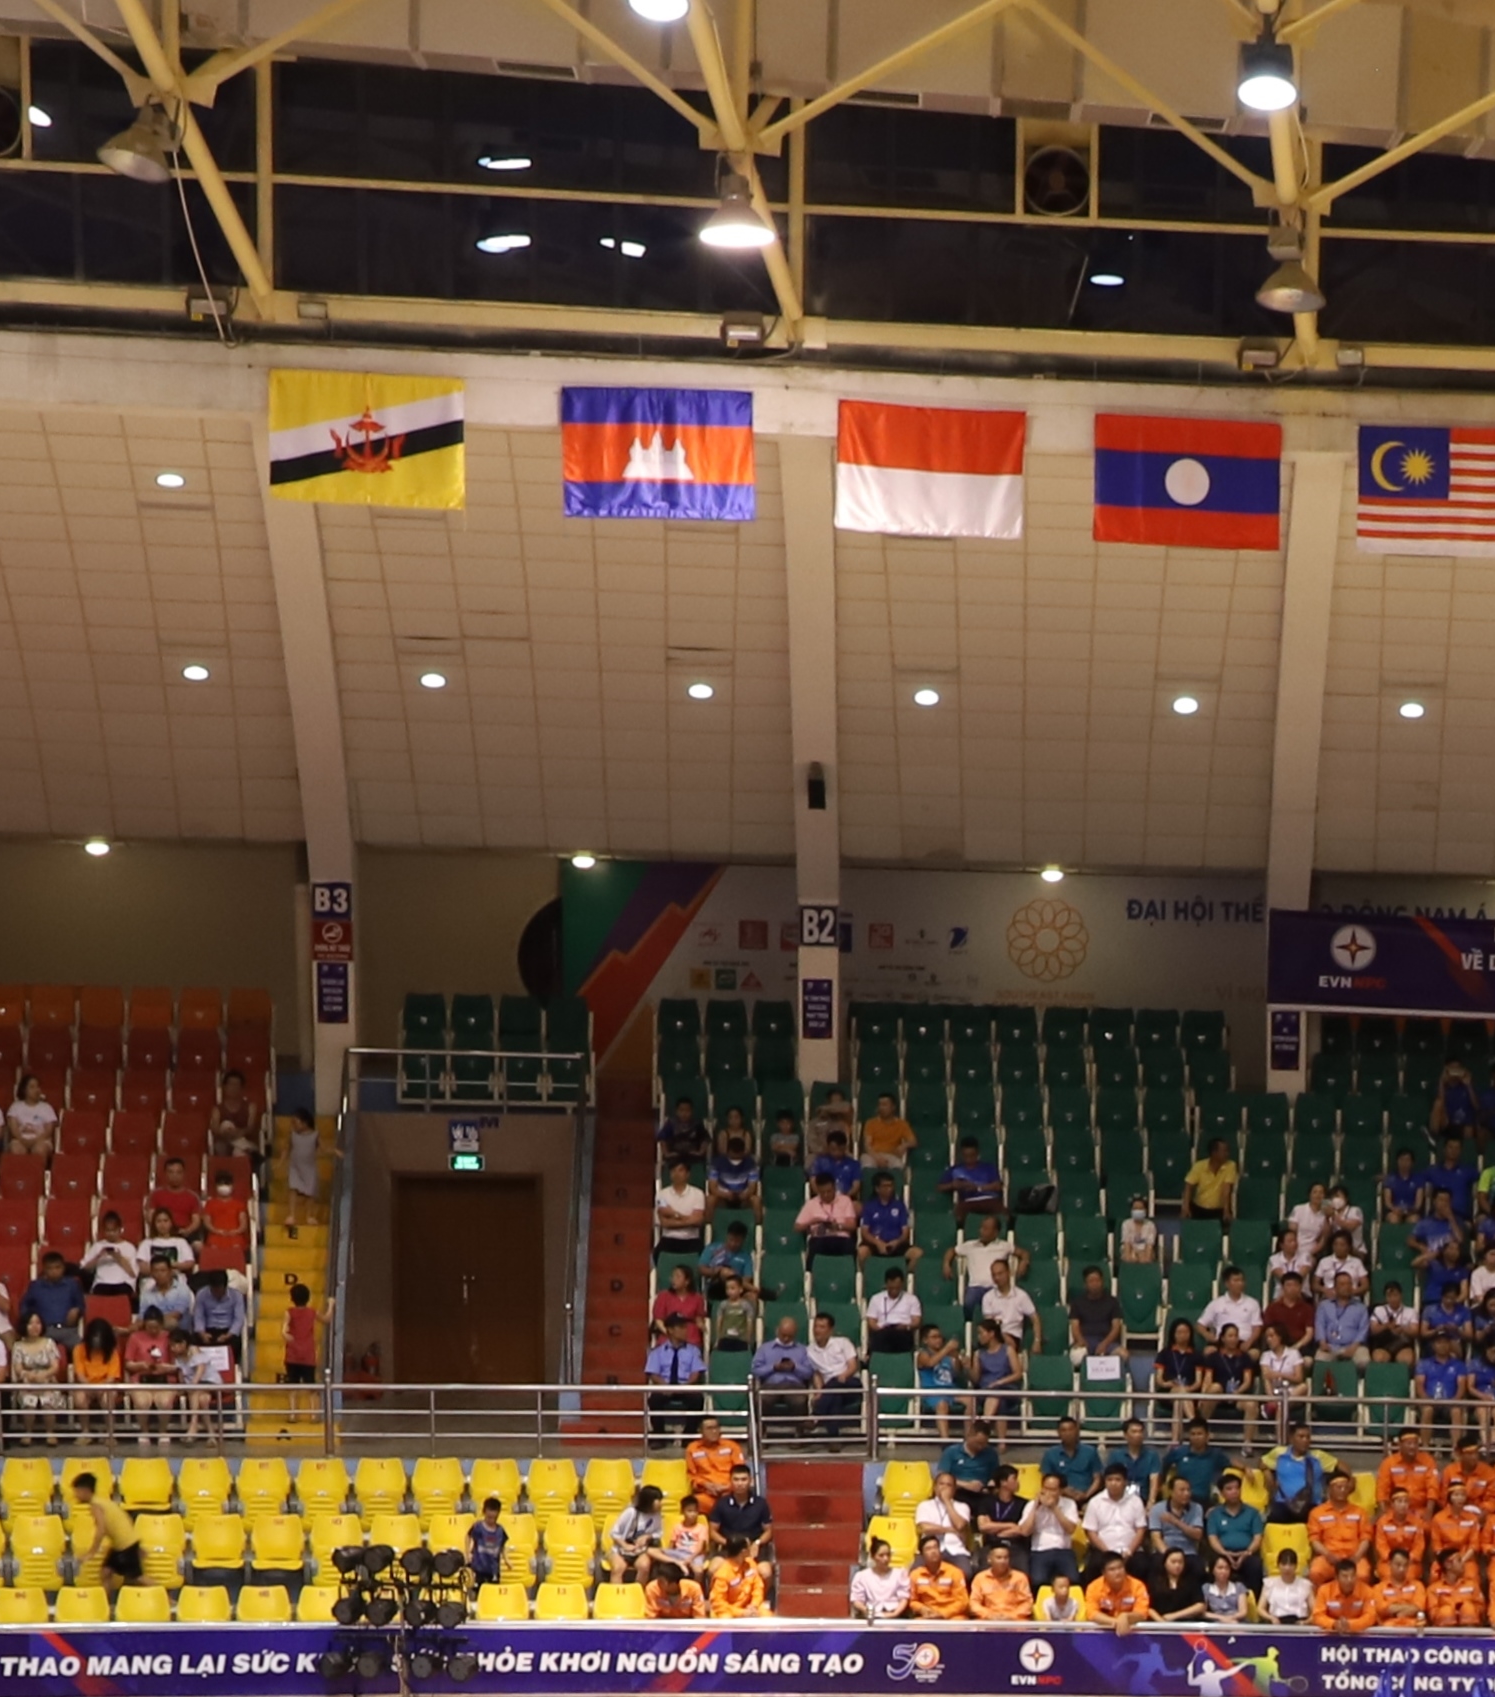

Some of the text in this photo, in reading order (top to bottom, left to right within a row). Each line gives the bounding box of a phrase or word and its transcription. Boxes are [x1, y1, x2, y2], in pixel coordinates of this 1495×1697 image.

[314, 887, 348, 913] B3
[1126, 899, 1166, 927] ĐẠI
[1174, 895, 1214, 927] HỘI
[802, 908, 836, 944] B2
[1461, 948, 1484, 972] VỀ
[1, 1654, 81, 1677] THAO
[86, 1654, 173, 1676] MANG
[181, 1653, 226, 1678] LẠI
[232, 1647, 290, 1676] SỨC
[539, 1645, 865, 1678] KHƠI NGUỒN SÁNG TẠO
[1011, 1674, 1063, 1685] EVNNPC
